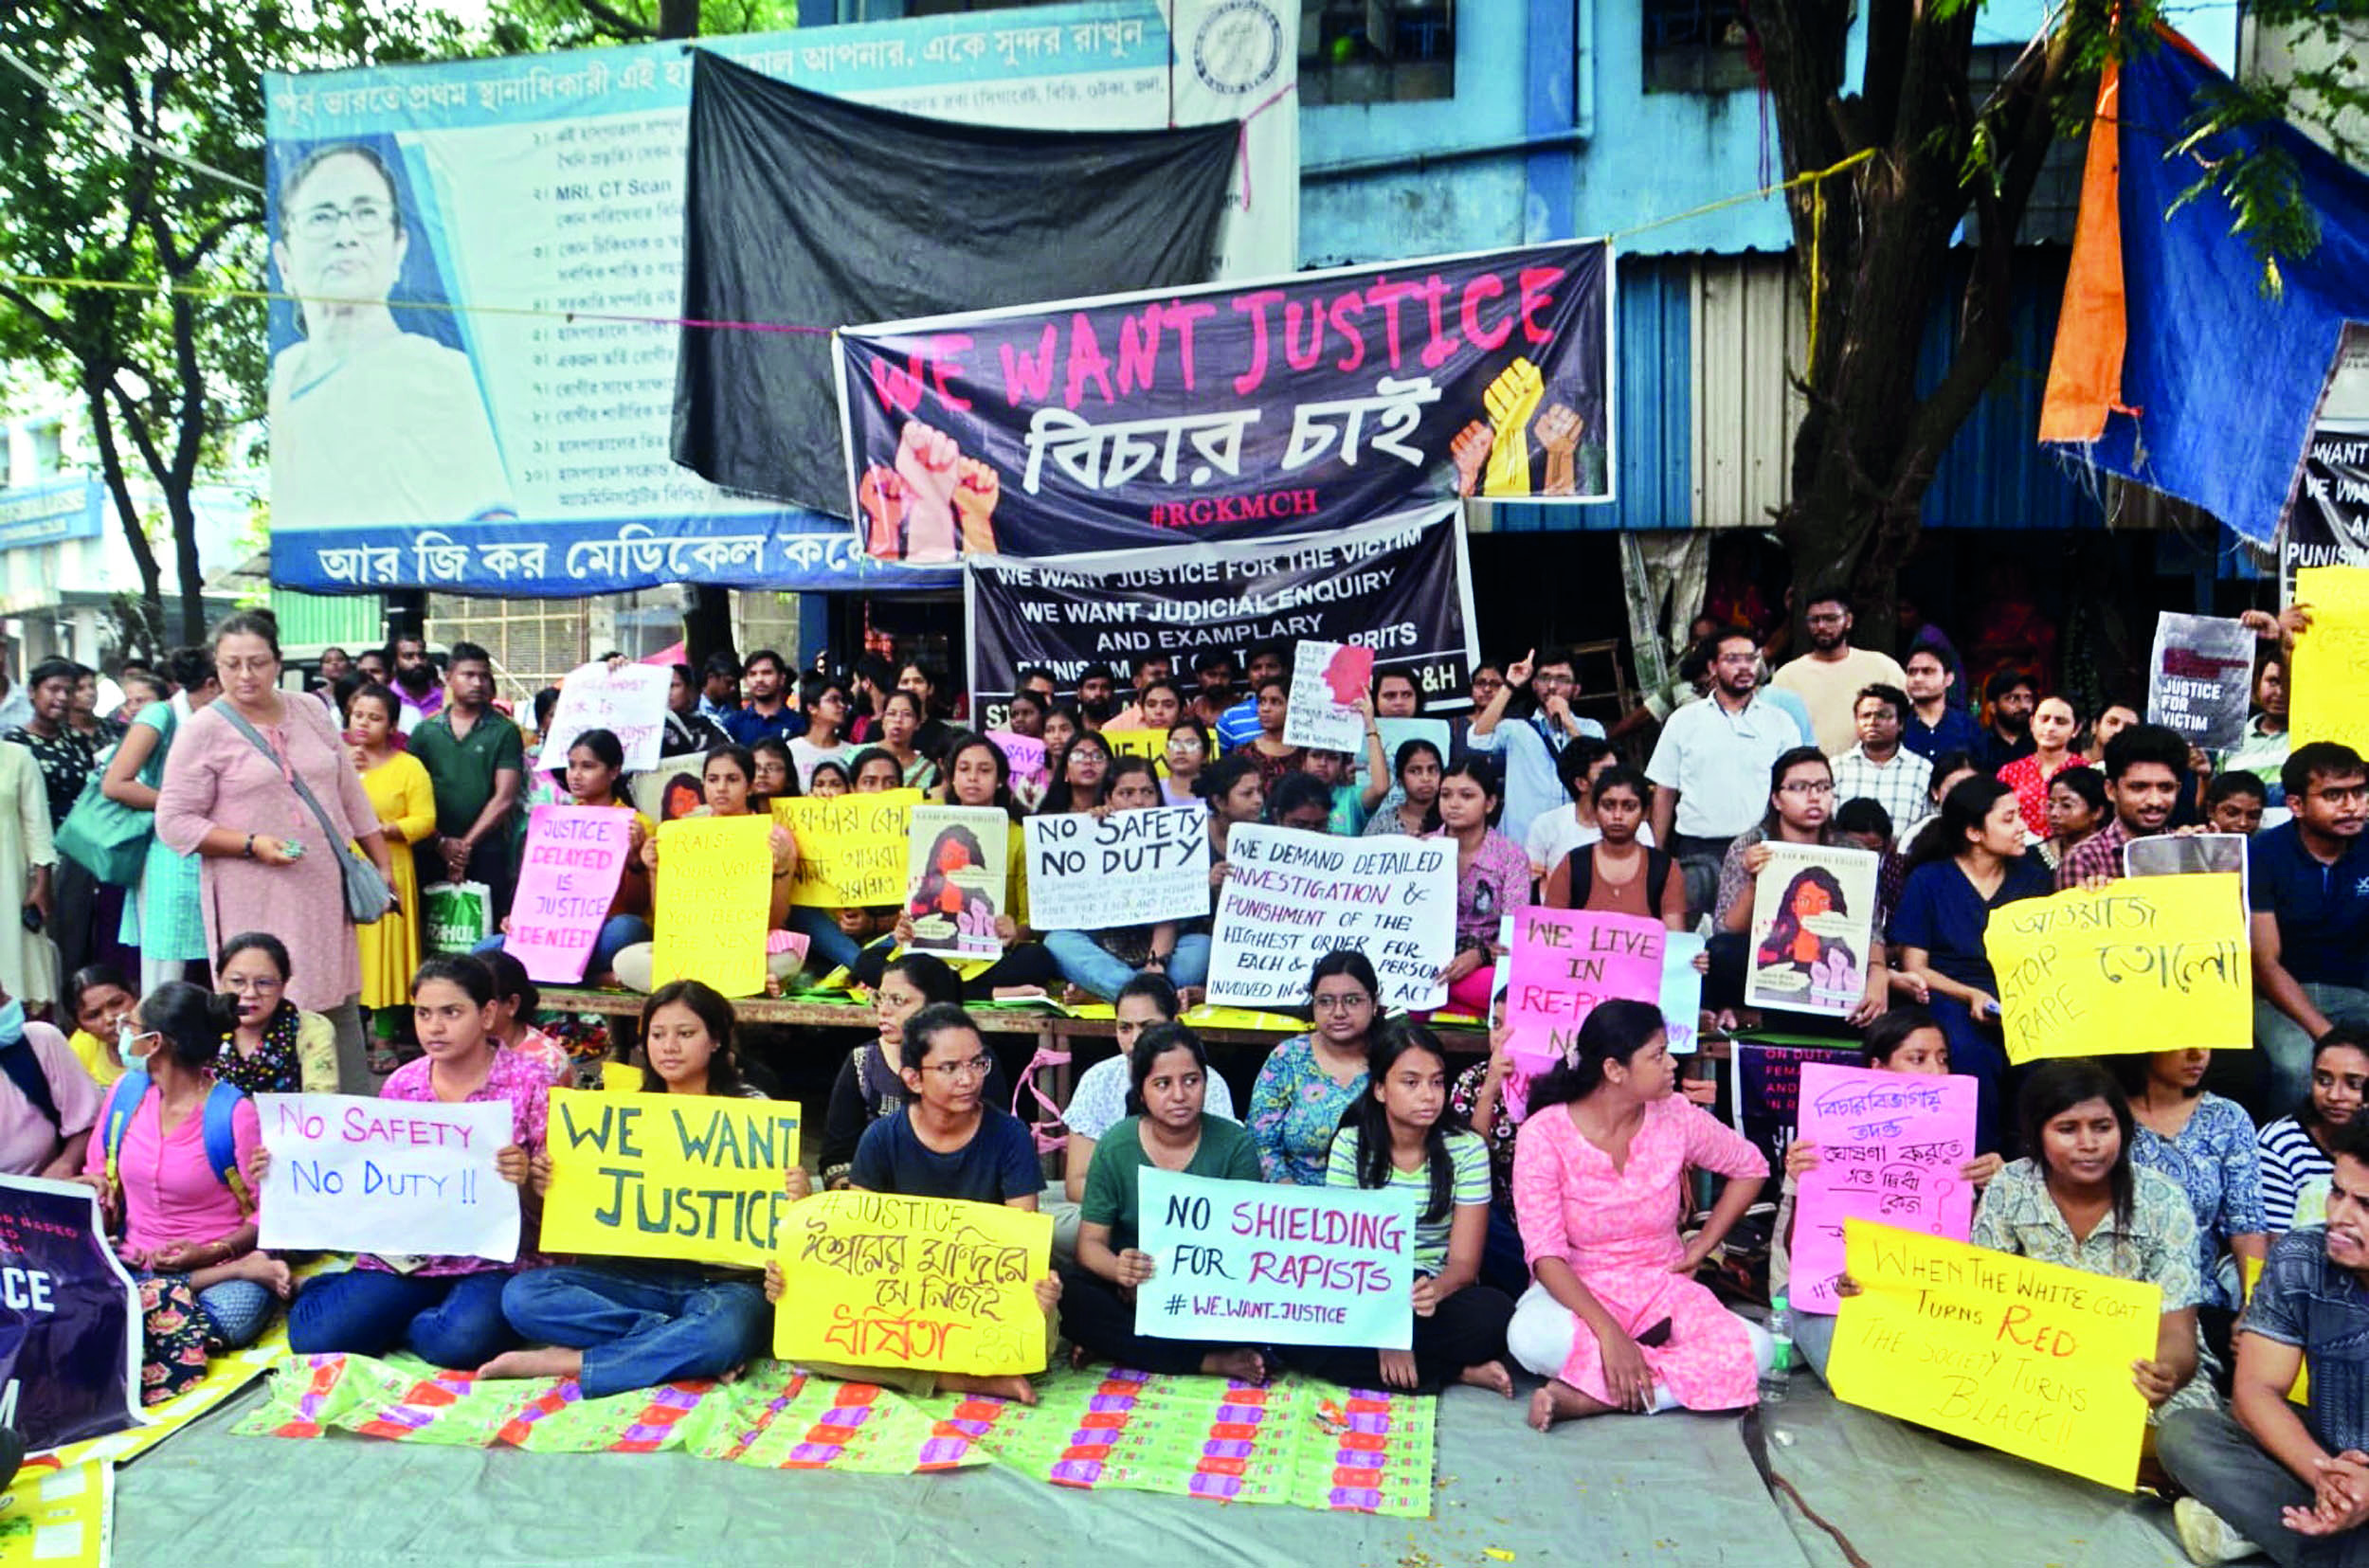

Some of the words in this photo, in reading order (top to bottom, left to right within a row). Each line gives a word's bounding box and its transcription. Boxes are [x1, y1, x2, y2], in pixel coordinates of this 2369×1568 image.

[627, 178, 671, 196] Scan
[872, 334, 974, 413] WE
[1000, 297, 1217, 409] WANT
[1232, 267, 1565, 395] JUSTICE
[1023, 407, 1261, 495] বিচার
[1281, 376, 1442, 471] চাই
[1149, 488, 1318, 529] #RGKMCH
[317, 542, 401, 585] আর
[411, 530, 470, 584] জি
[477, 542, 549, 580] কর
[567, 523, 768, 579] মেডিকেল
[997, 567, 1033, 586] WE
[1040, 568, 1107, 588] WANT
[1116, 563, 1220, 587] JUSTICE
[1226, 557, 1279, 580] FOR
[1288, 547, 1335, 572] THE
[1020, 601, 1060, 623] WE
[1064, 601, 1140, 623] WANT
[1148, 594, 1272, 622] JUDICIAL
[1278, 568, 1396, 608] ENQUIRY
[1096, 631, 1150, 652] AND
[1158, 613, 1324, 648] EXAMPLARY
[2161, 696, 2189, 713] FOR
[2162, 678, 2222, 702] JUSTICE
[2161, 711, 2208, 731] VICTIM
[544, 820, 612, 842] JUSTICE
[673, 832, 735, 854] RAISE
[1038, 820, 1076, 843] NO
[1094, 808, 1205, 845] SAFETY
[532, 845, 613, 871] DELAYED
[1042, 851, 1085, 876] NO
[1103, 837, 1203, 874] DUTY
[1233, 838, 1261, 859] WE
[1269, 842, 1344, 872] DEMAND
[1352, 851, 1443, 875] DETAILED
[556, 873, 573, 892] IS
[1232, 865, 1391, 905] INVESTIGATION
[535, 895, 609, 918] JUSTICE
[1225, 895, 1327, 928] PUNISHMENT
[1339, 910, 1362, 928] OF
[1374, 913, 1413, 931] THE
[2012, 896, 2157, 933] আওয়াজ
[518, 926, 592, 948] DENIED
[1223, 926, 1304, 949] HIGHEST
[1311, 934, 1370, 952] ORDER
[1383, 940, 1424, 960] FOR
[1528, 917, 1573, 949] WE
[1590, 926, 1659, 960] LIVE
[1238, 952, 1284, 971] EACH
[1378, 958, 1441, 979] PERSON
[1566, 958, 1605, 982] IN
[2004, 944, 2057, 1019] STOP
[2094, 941, 2239, 994] তোলো
[1210, 980, 1273, 997] INVOLVED
[1277, 982, 1293, 999] IN
[1395, 982, 1433, 1002] ACT
[2014, 982, 2085, 1054] RAPE
[280, 1103, 324, 1139] NO
[343, 1107, 474, 1148] SAFETY
[561, 1102, 642, 1158] WE
[671, 1108, 798, 1169] WANT
[1848, 1115, 1913, 1141] তদন্ত
[292, 1160, 343, 1195] NO
[365, 1161, 448, 1197] DUTY
[594, 1167, 788, 1251] JUSTICE
[1166, 1194, 1211, 1231] NO
[1232, 1200, 1406, 1254] SHIELDING
[1172, 1244, 1238, 1280] FOR
[1248, 1251, 1392, 1295] RAPISTS
[1873, 1239, 1962, 1286] WHEN
[1969, 1257, 2007, 1294] THE
[2016, 1269, 2088, 1310] WHITE
[2092, 1294, 2142, 1321] COAT
[1919, 1289, 1982, 1325] TURNS
[1996, 1305, 2080, 1358] RED
[1861, 1317, 1906, 1353] THE
[1919, 1343, 2002, 1378] SOCIETY
[2013, 1357, 2088, 1412] TURNS
